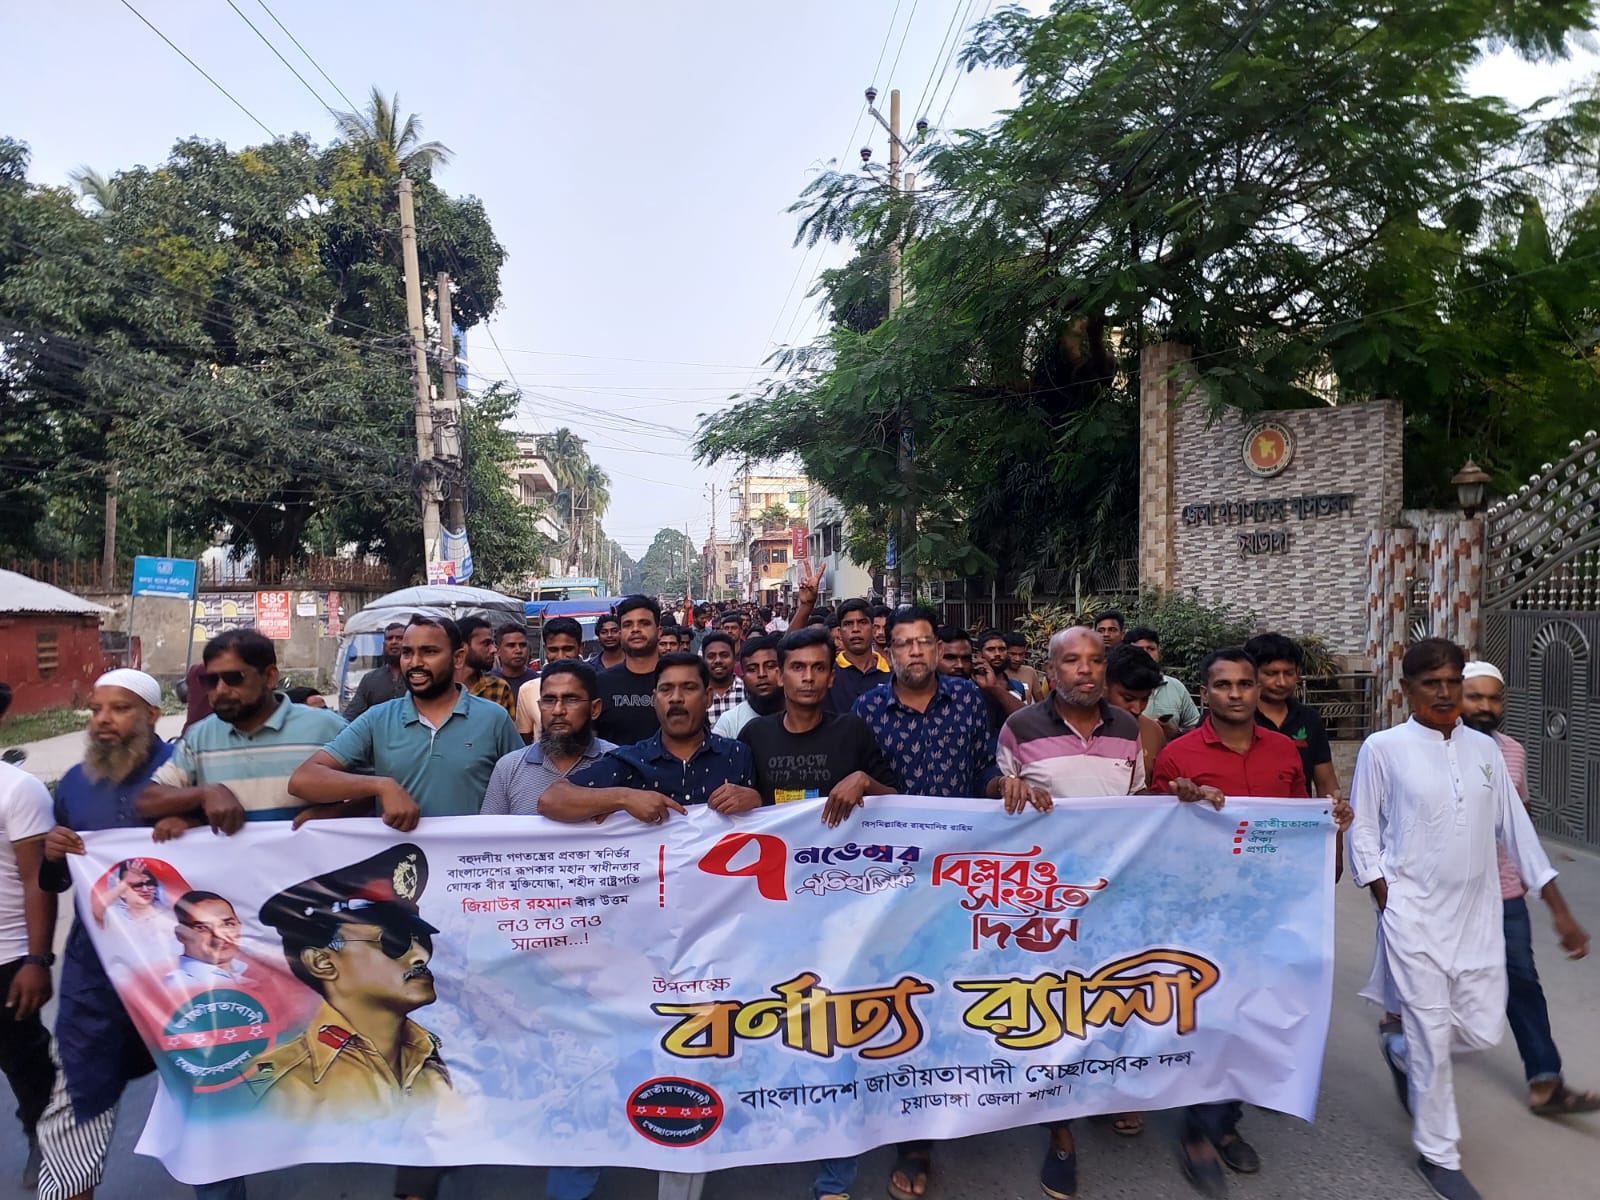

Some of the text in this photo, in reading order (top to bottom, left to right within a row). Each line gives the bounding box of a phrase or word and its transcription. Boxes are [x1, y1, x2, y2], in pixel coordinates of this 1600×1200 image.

[261, 592, 285, 603] SSC
[457, 851, 503, 865] বহুদলীয়
[558, 850, 591, 860] প্রবক্তা
[594, 847, 631, 859] স্বনির্ভর
[793, 842, 924, 866] নভেম্বর
[447, 861, 641, 879] বাংলাদেশের রূপকার মহান স্বাধীনতার
[698, 832, 788, 901] ৭
[485, 878, 506, 890] বীর
[567, 875, 596, 888] শহীদ
[598, 873, 641, 887] রাষ্ট্রপতি
[462, 895, 629, 914] জিয়াউর রহমান বীর উত্তম
[497, 915, 602, 933] লও লও লও
[971, 910, 1079, 952] দিবস
[652, 977, 731, 994] উপলক্ষে
[650, 971, 935, 1059] বর্ণাঢ্য
[738, 1051, 1194, 1110] বাংলাদেশ জাতীয়তাবাদী স্বেচ্ছাসেবক দল
[901, 1093, 970, 1114] চুয়াডাঙ্গা
[977, 1091, 1022, 1107] জেলা
